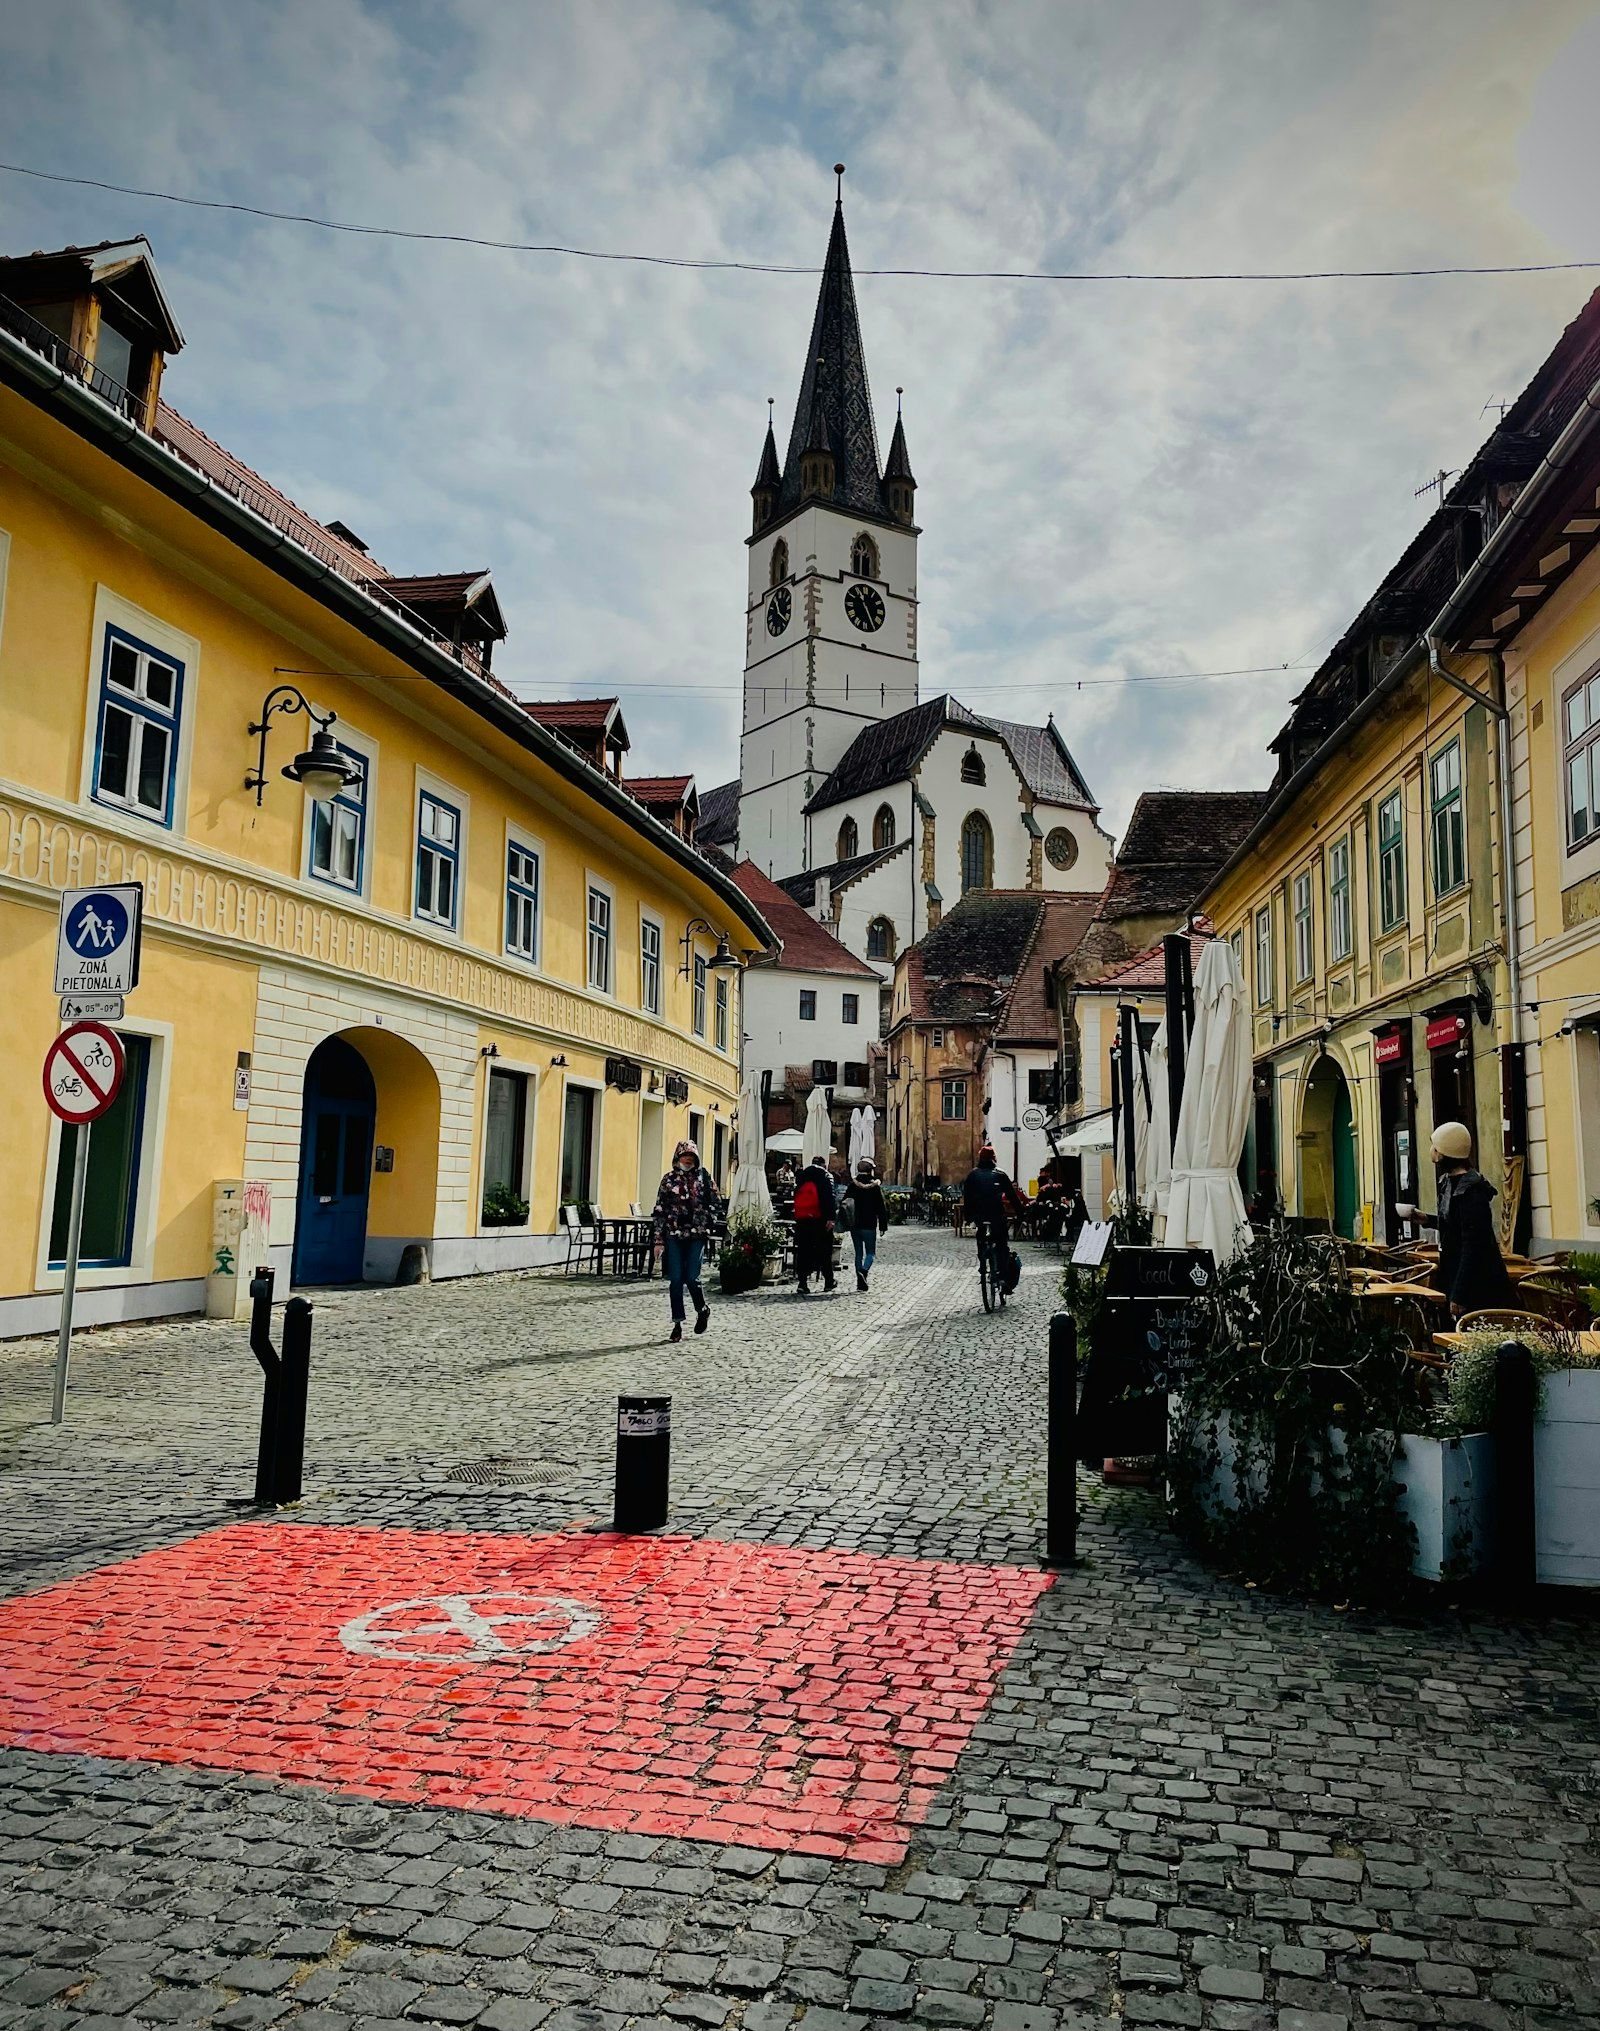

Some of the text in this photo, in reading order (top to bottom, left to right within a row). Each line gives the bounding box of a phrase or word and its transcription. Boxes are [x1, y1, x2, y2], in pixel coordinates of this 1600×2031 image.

[79, 959, 108, 974] ZONĂ
[62, 974, 122, 990] PIETONALĂ
[1138, 1256, 1176, 1285] Local
